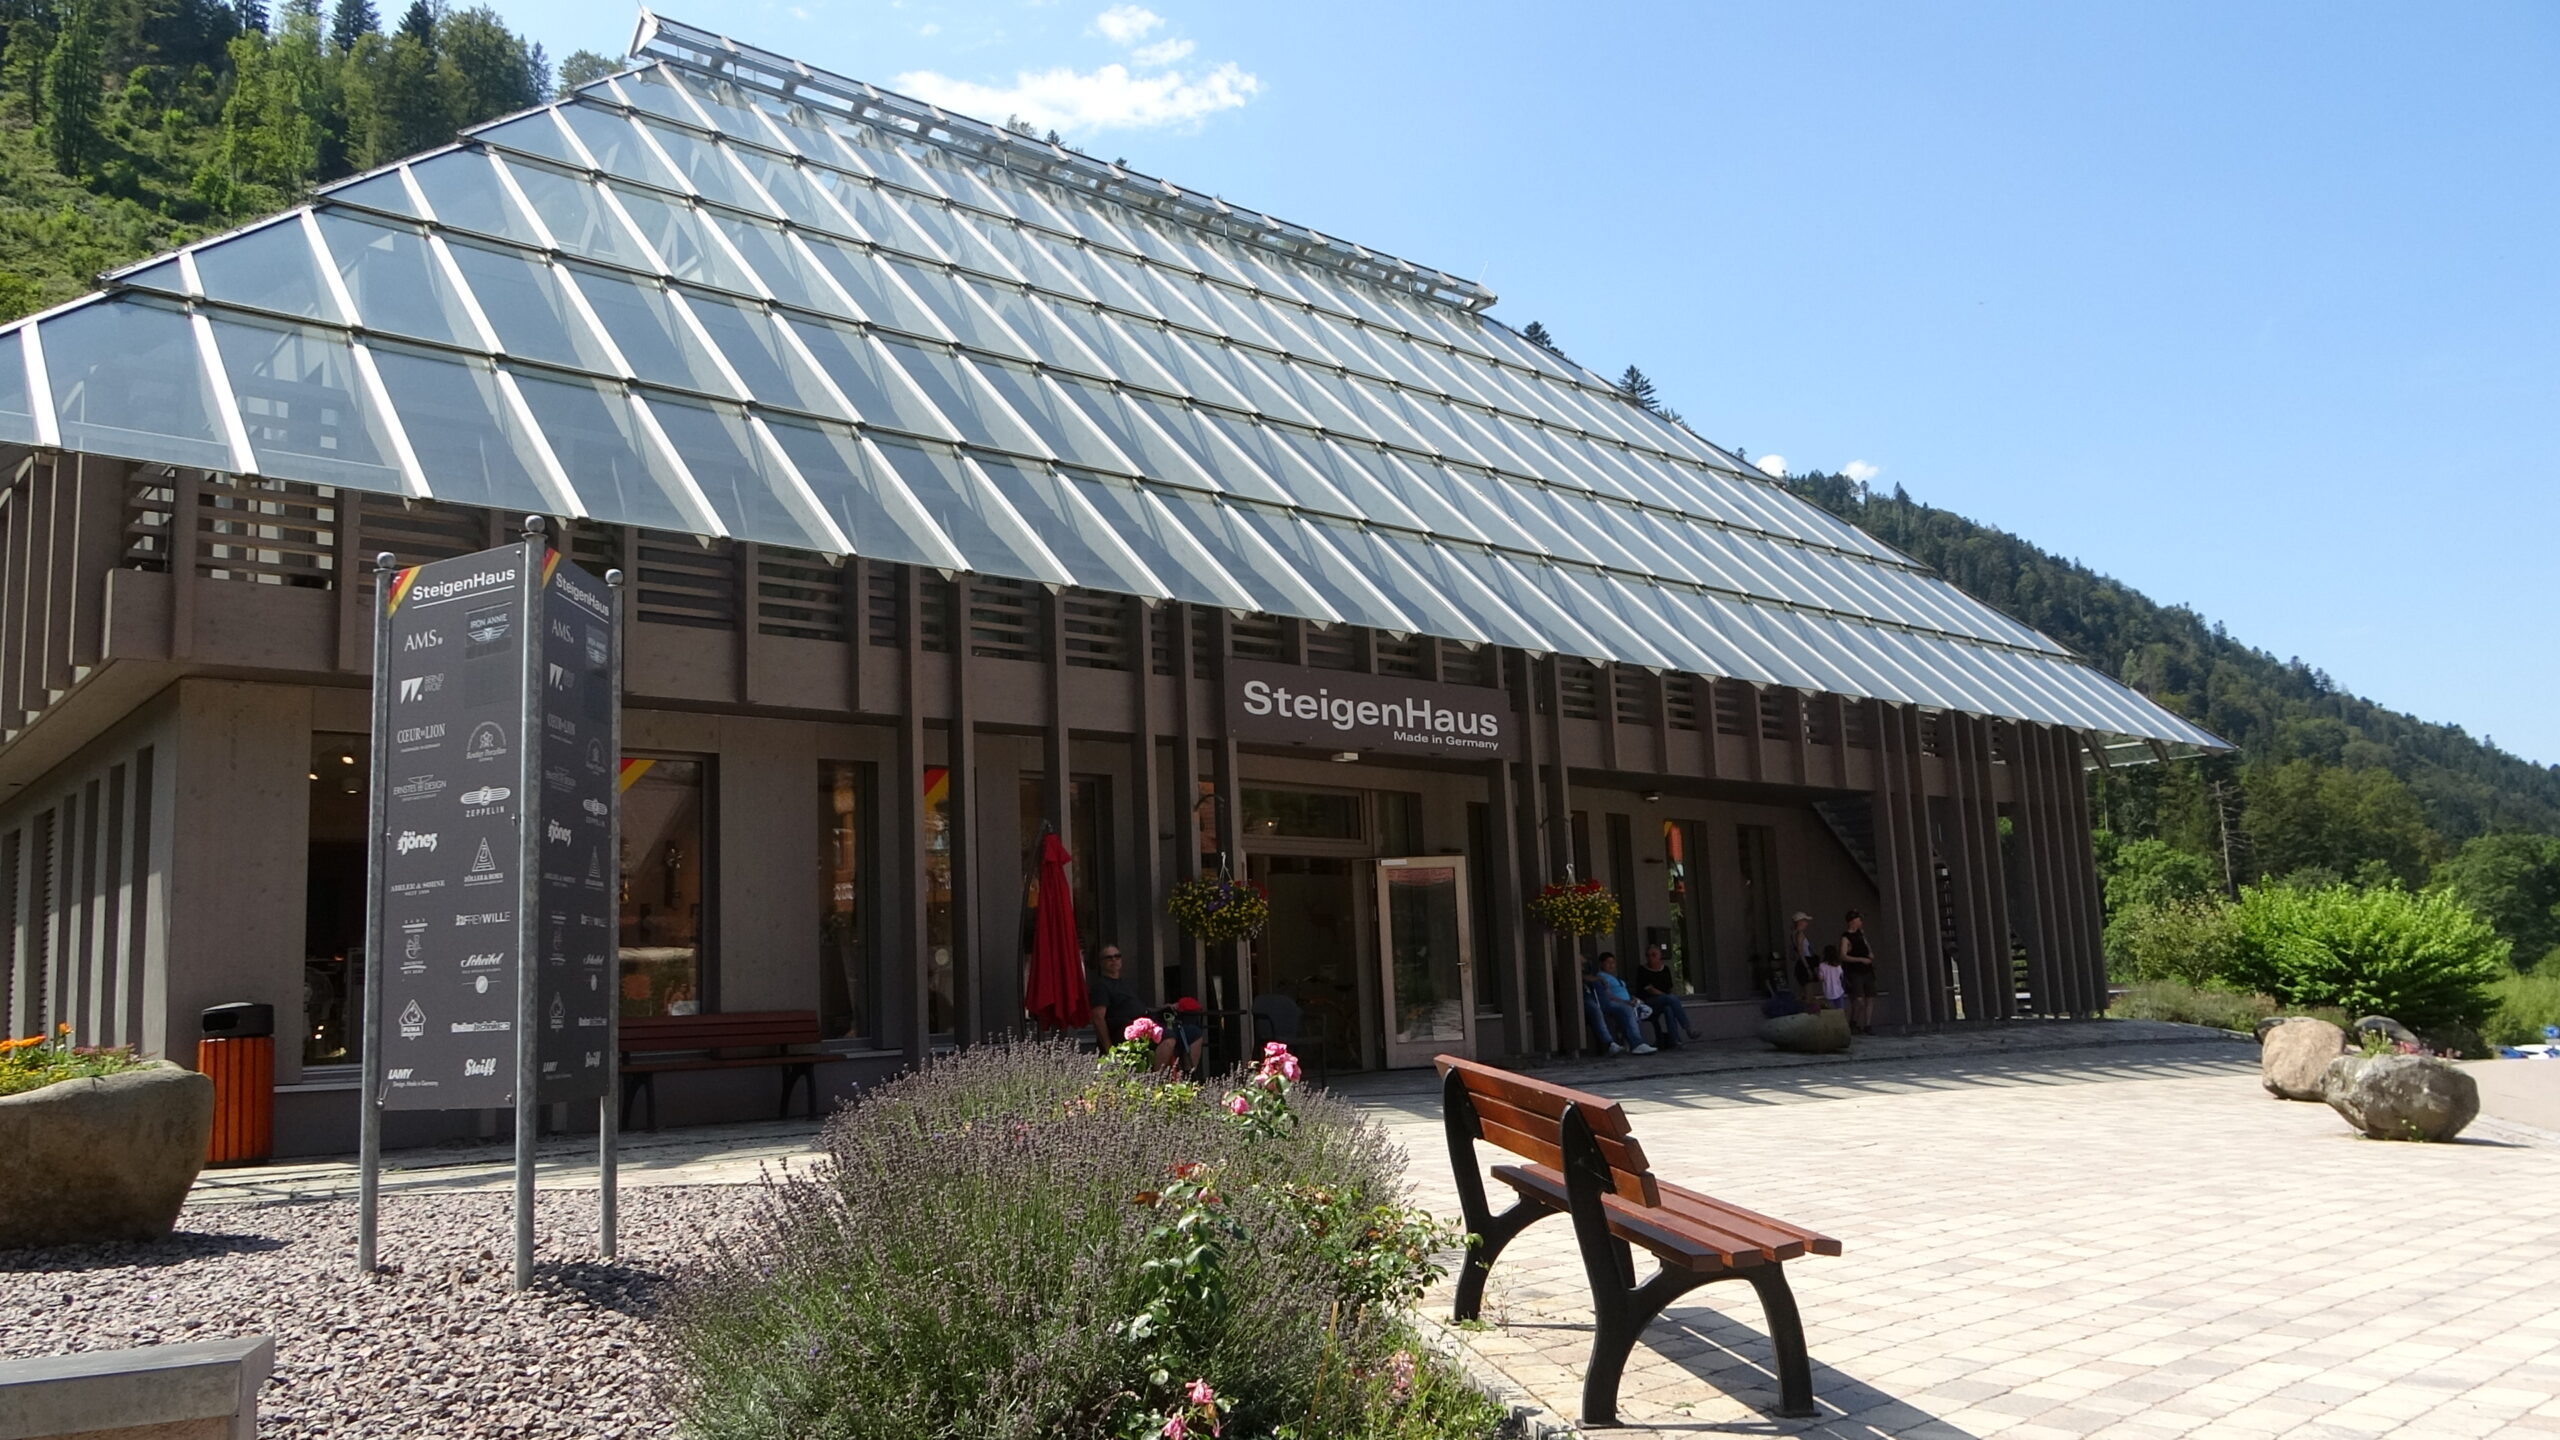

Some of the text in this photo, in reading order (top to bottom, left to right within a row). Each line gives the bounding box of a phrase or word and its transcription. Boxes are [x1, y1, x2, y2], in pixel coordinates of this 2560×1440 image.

[412, 568, 516, 601] SteigenHaus
[555, 572, 609, 617] SteigenHaus
[1243, 680, 1499, 737] SteigenHaus
[425, 723, 446, 739] LION
[1393, 730, 1499, 751] Made in Germany
[424, 780, 447, 791] DESIGN
[466, 805, 505, 818] ZEPPELIN
[388, 1068, 414, 1080] LAMY
[464, 1058, 497, 1077] Steiff
